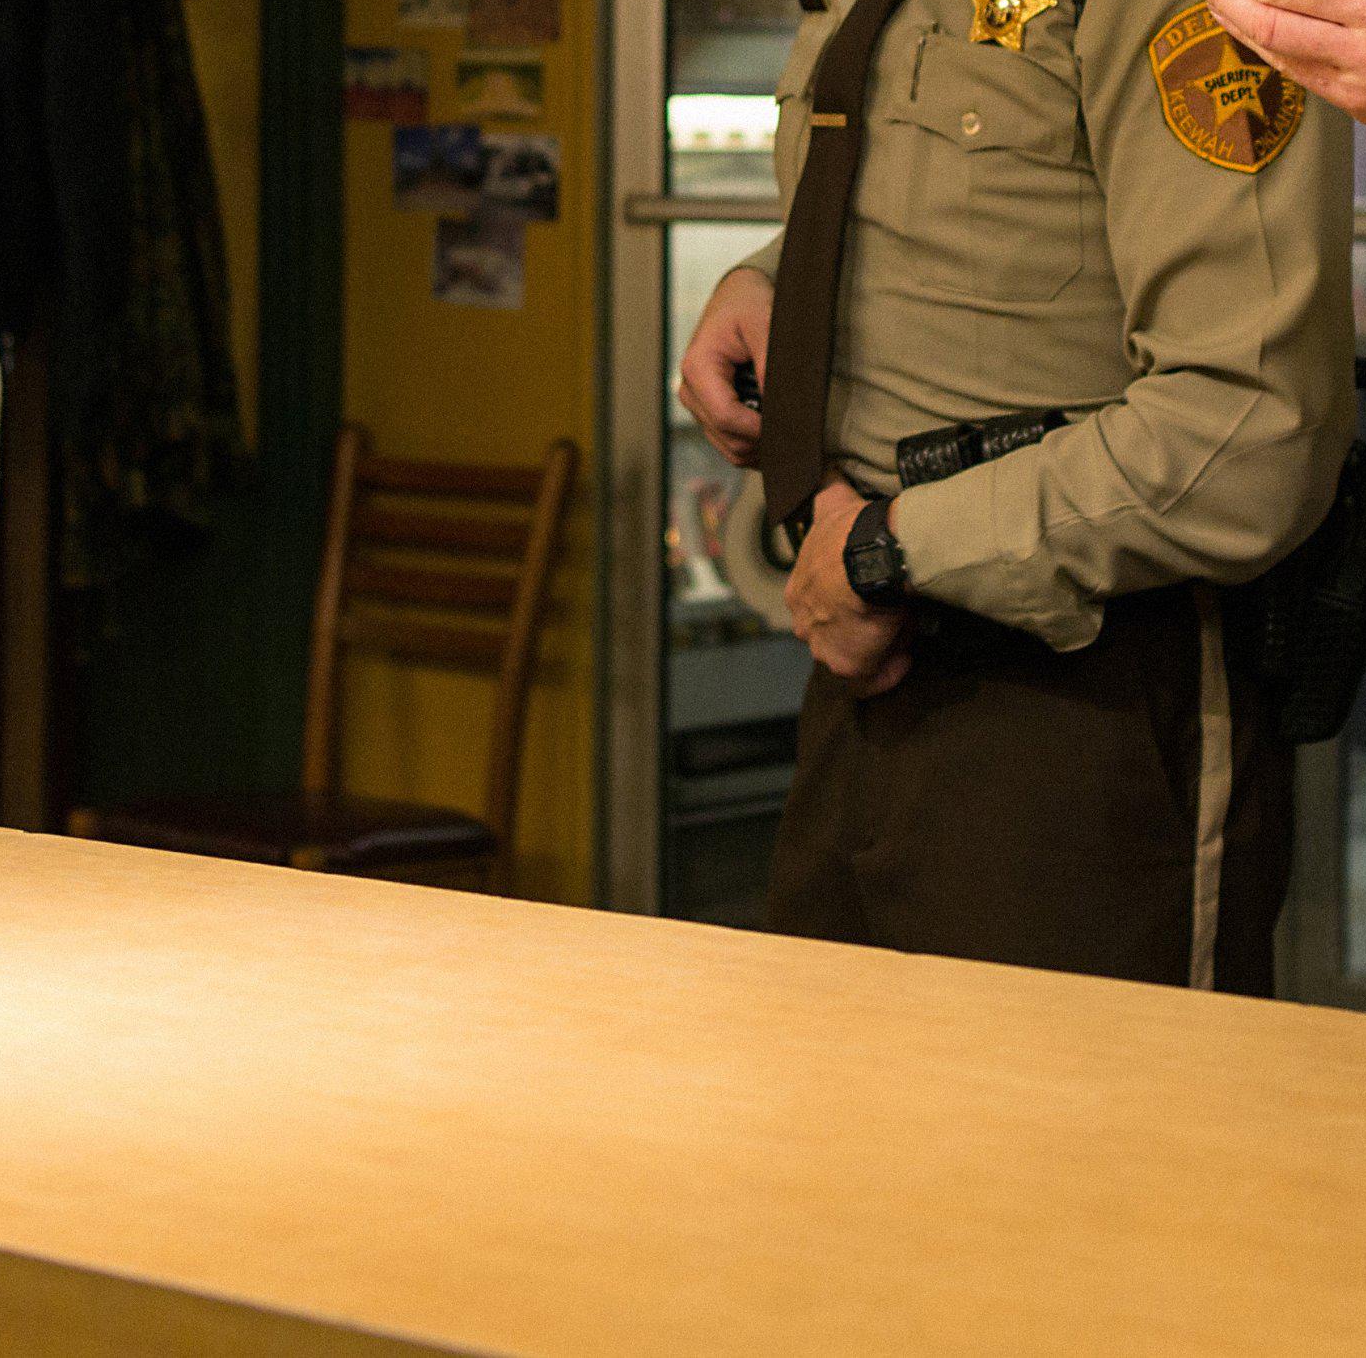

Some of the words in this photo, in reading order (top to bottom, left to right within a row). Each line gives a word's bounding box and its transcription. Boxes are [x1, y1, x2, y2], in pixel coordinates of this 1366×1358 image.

[1165, 11, 1216, 47] DEP
[1205, 69, 1261, 93] SHERIFF'S
[1169, 89, 1235, 159] KEEWAH
